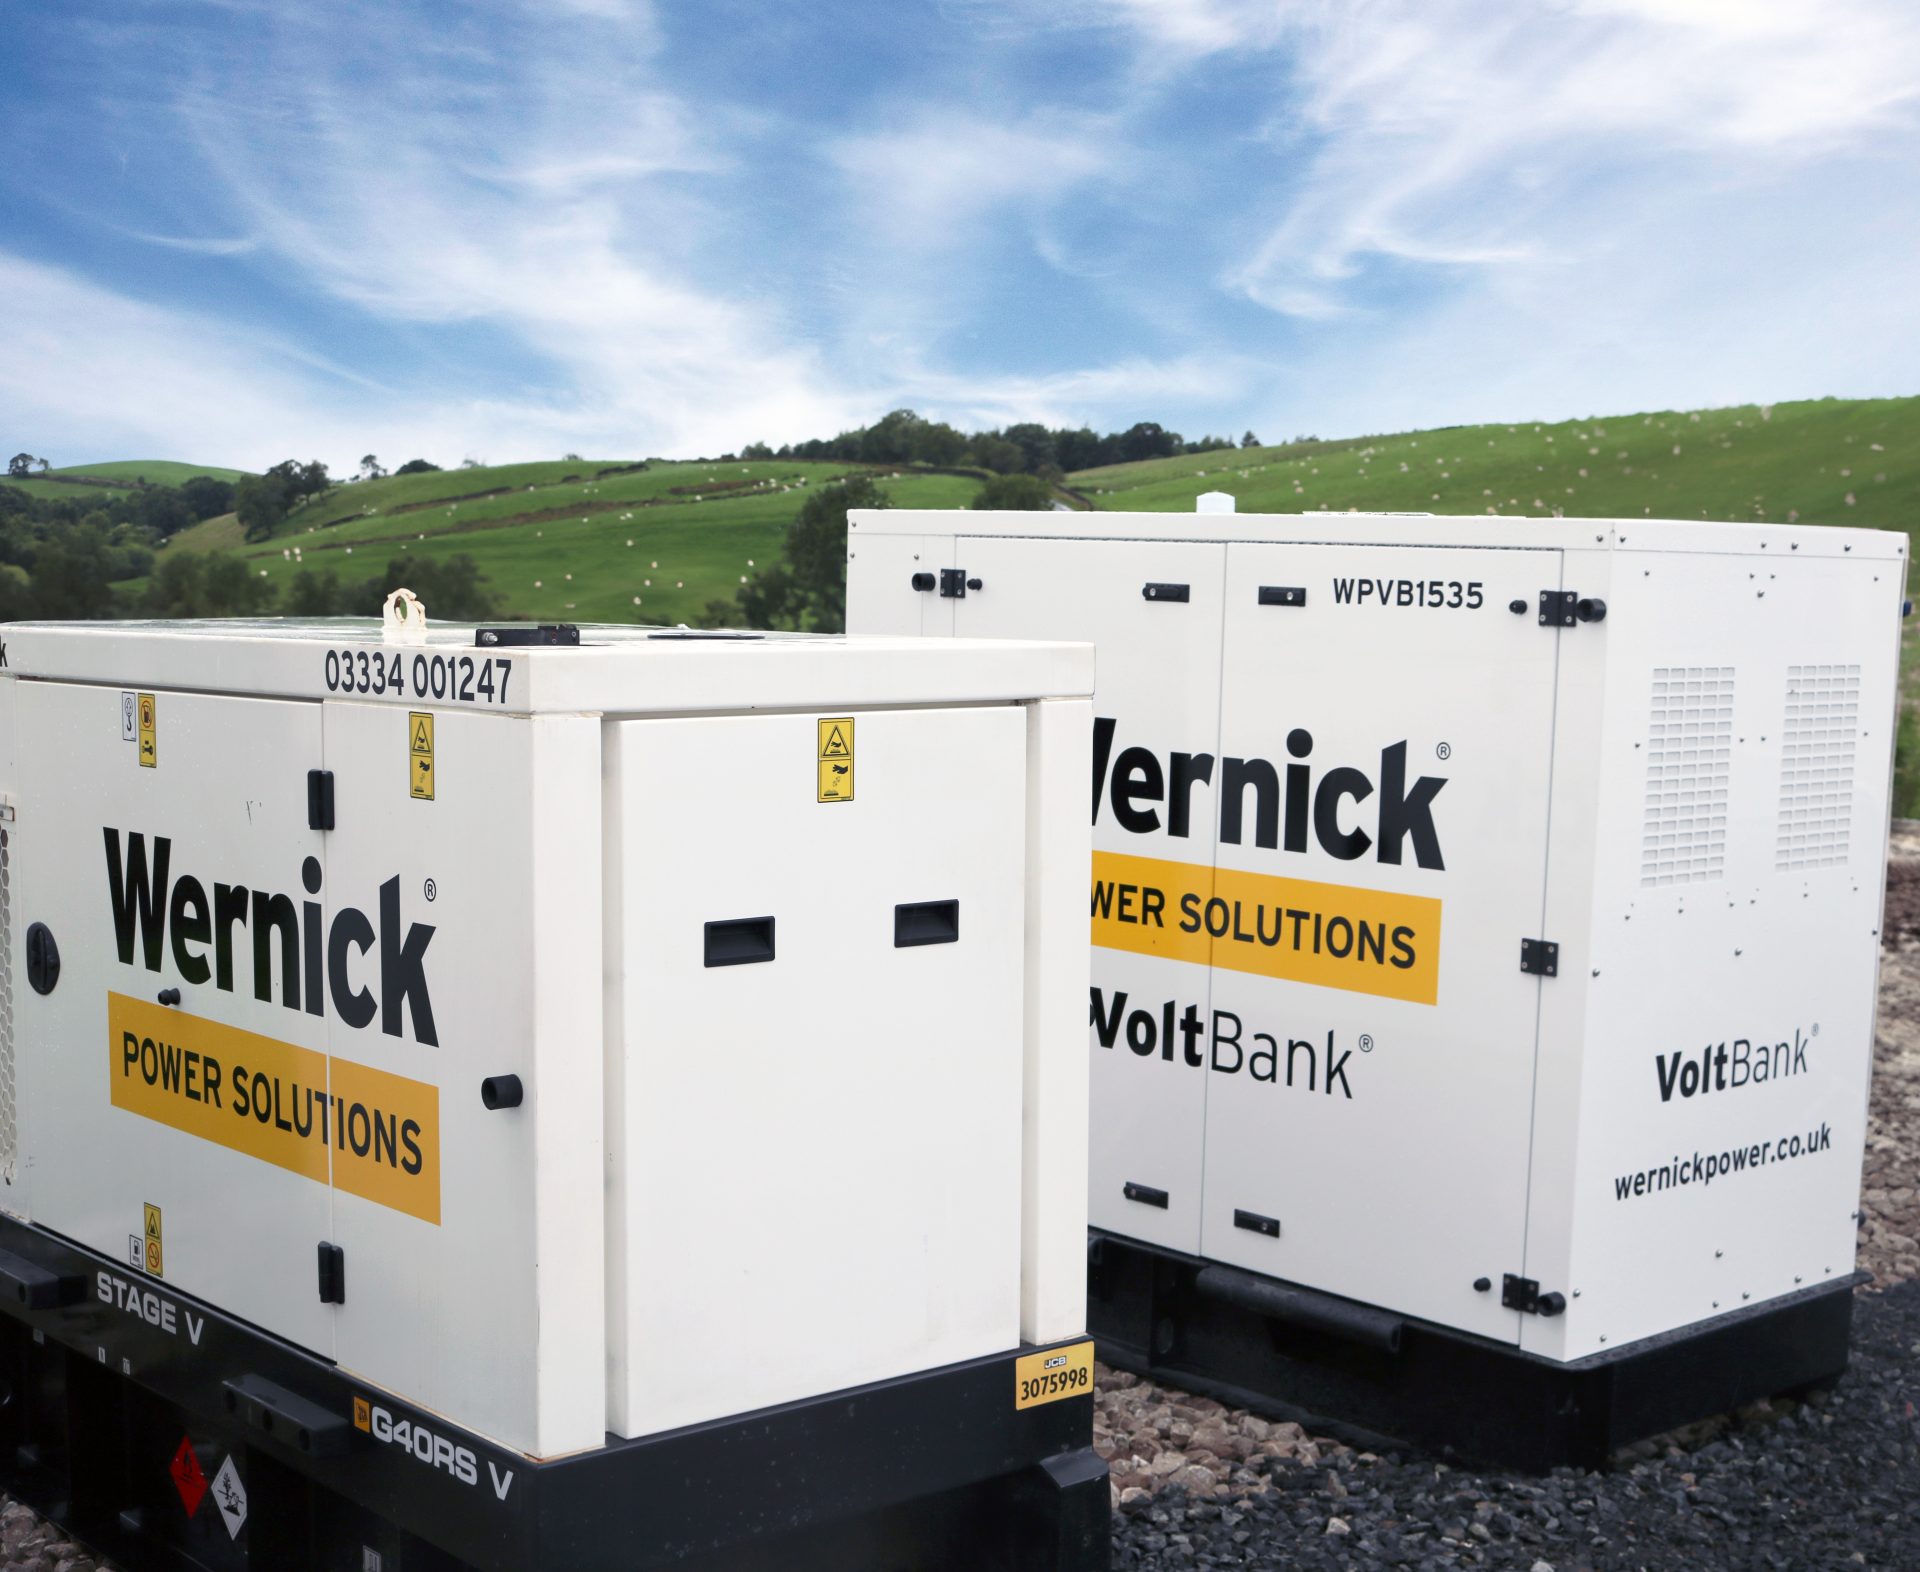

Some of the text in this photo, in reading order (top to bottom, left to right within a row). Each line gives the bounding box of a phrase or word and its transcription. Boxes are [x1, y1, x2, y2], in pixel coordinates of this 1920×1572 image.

[1333, 578, 1484, 609] WPVB1535
[325, 649, 512, 704] 03334 001247
[1091, 880, 1417, 970] WER SOLUTIONS
[123, 1031, 423, 1176] POWER SOLUTIONS
[1614, 1121, 1832, 1201] wernickpower.co.uk
[97, 1271, 204, 1346] STAGE V
[1021, 1367, 1088, 1401] 3075998
[1044, 1356, 1067, 1368] JCB
[371, 1406, 514, 1501] G40RS V
